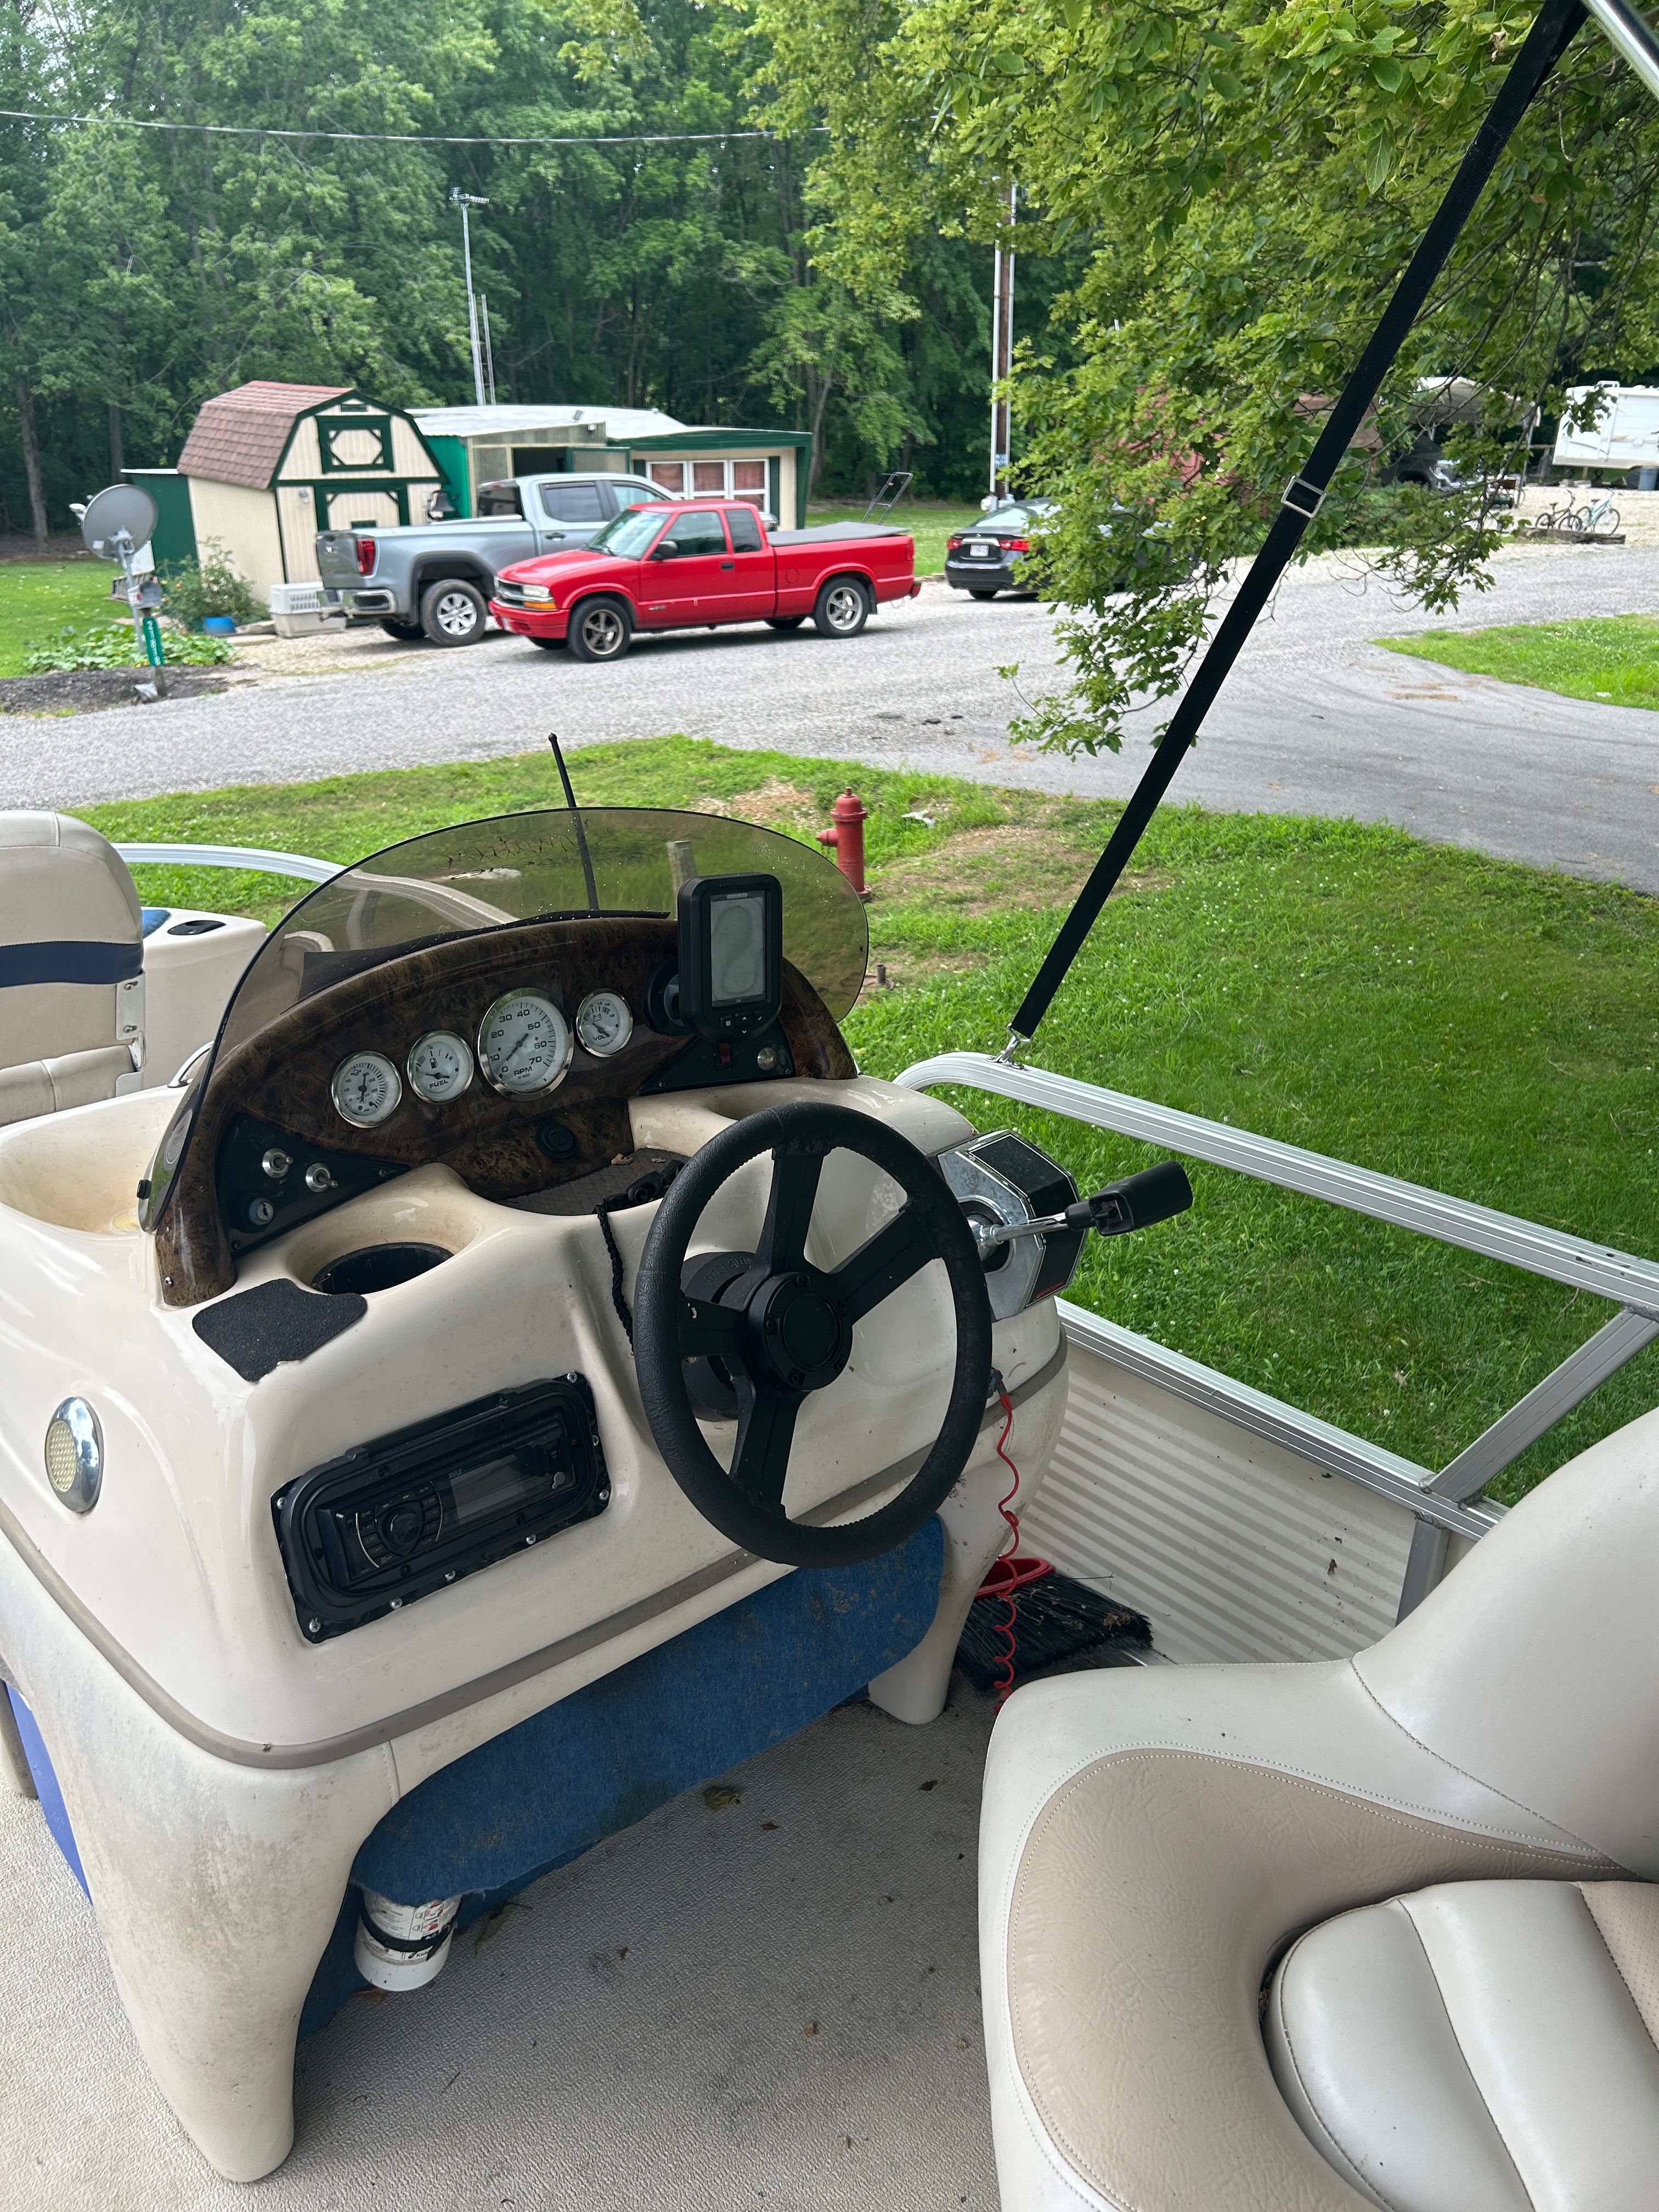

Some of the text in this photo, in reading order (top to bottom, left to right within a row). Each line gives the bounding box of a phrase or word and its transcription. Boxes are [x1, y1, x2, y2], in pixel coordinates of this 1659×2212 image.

[517, 1009, 530, 1017] 40
[499, 1014, 512, 1023] 30
[527, 1022, 540, 1030] 50
[491, 1030, 504, 1039] 20
[534, 1041, 547, 1049] 60
[489, 1053, 500, 1062] 10
[529, 1056, 542, 1065] 70
[514, 1066, 532, 1076] RPM
[429, 1079, 448, 1089] FUEL
